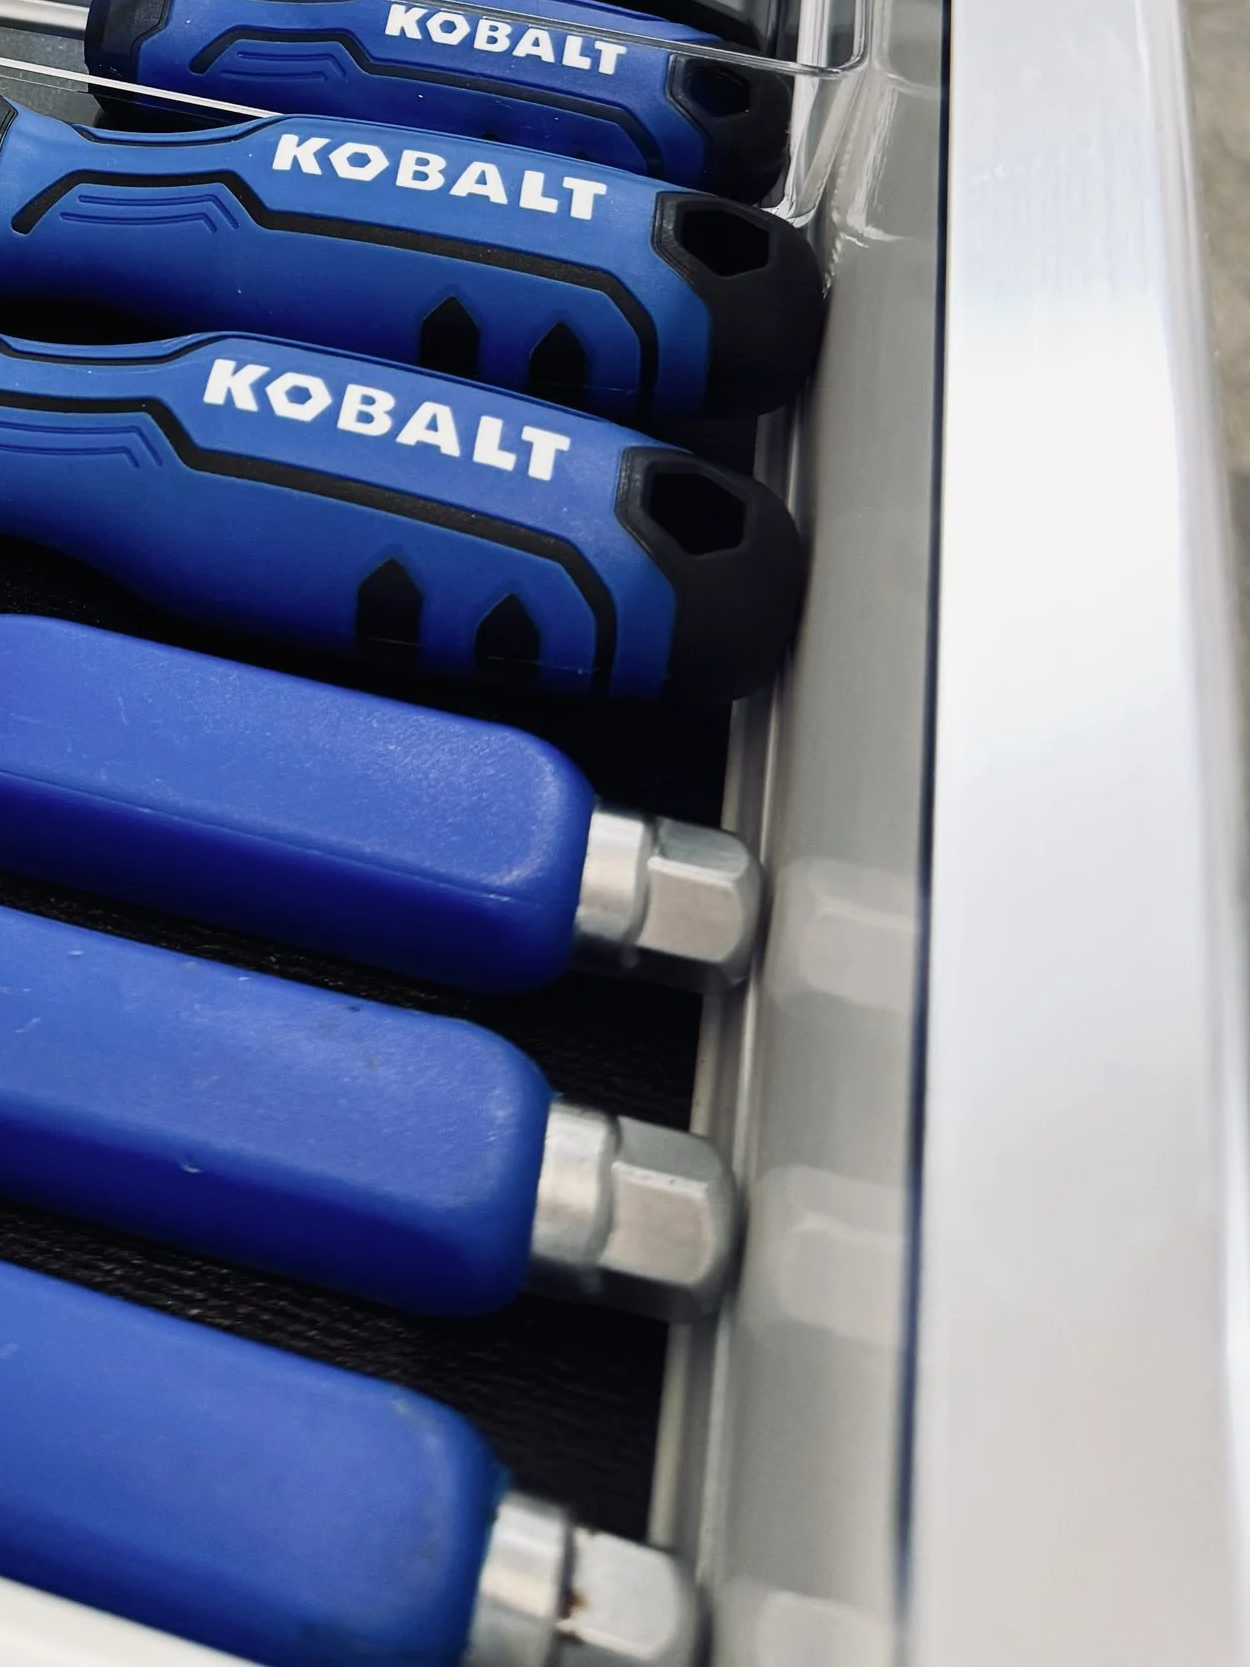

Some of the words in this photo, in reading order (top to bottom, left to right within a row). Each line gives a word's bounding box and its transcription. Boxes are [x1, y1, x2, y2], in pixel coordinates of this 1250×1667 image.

[384, 3, 627, 75] KOBALT
[272, 133, 608, 220] KOBALT
[203, 358, 571, 481] KOBALT
